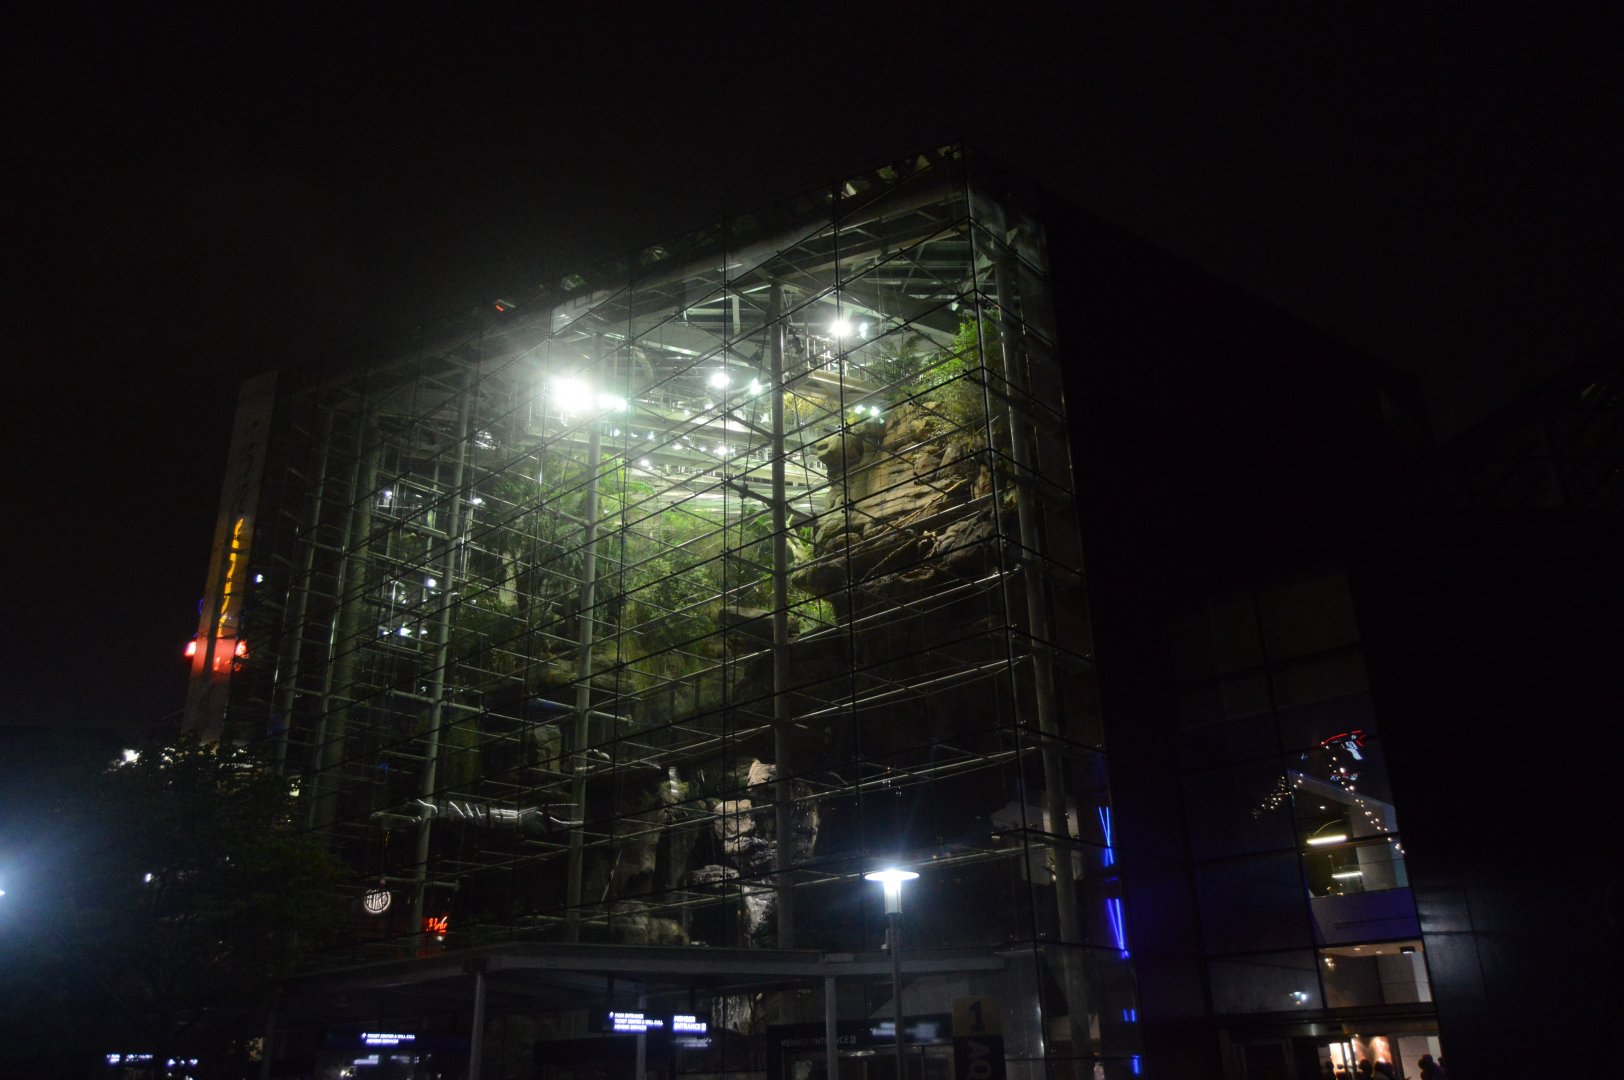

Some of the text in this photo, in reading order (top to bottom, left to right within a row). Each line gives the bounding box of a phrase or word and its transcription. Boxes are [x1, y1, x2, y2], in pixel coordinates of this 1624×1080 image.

[969, 1000, 986, 1031] 1
[673, 1022, 701, 1031] ENTRANCE
[810, 1035, 849, 1046] ENTNCE
